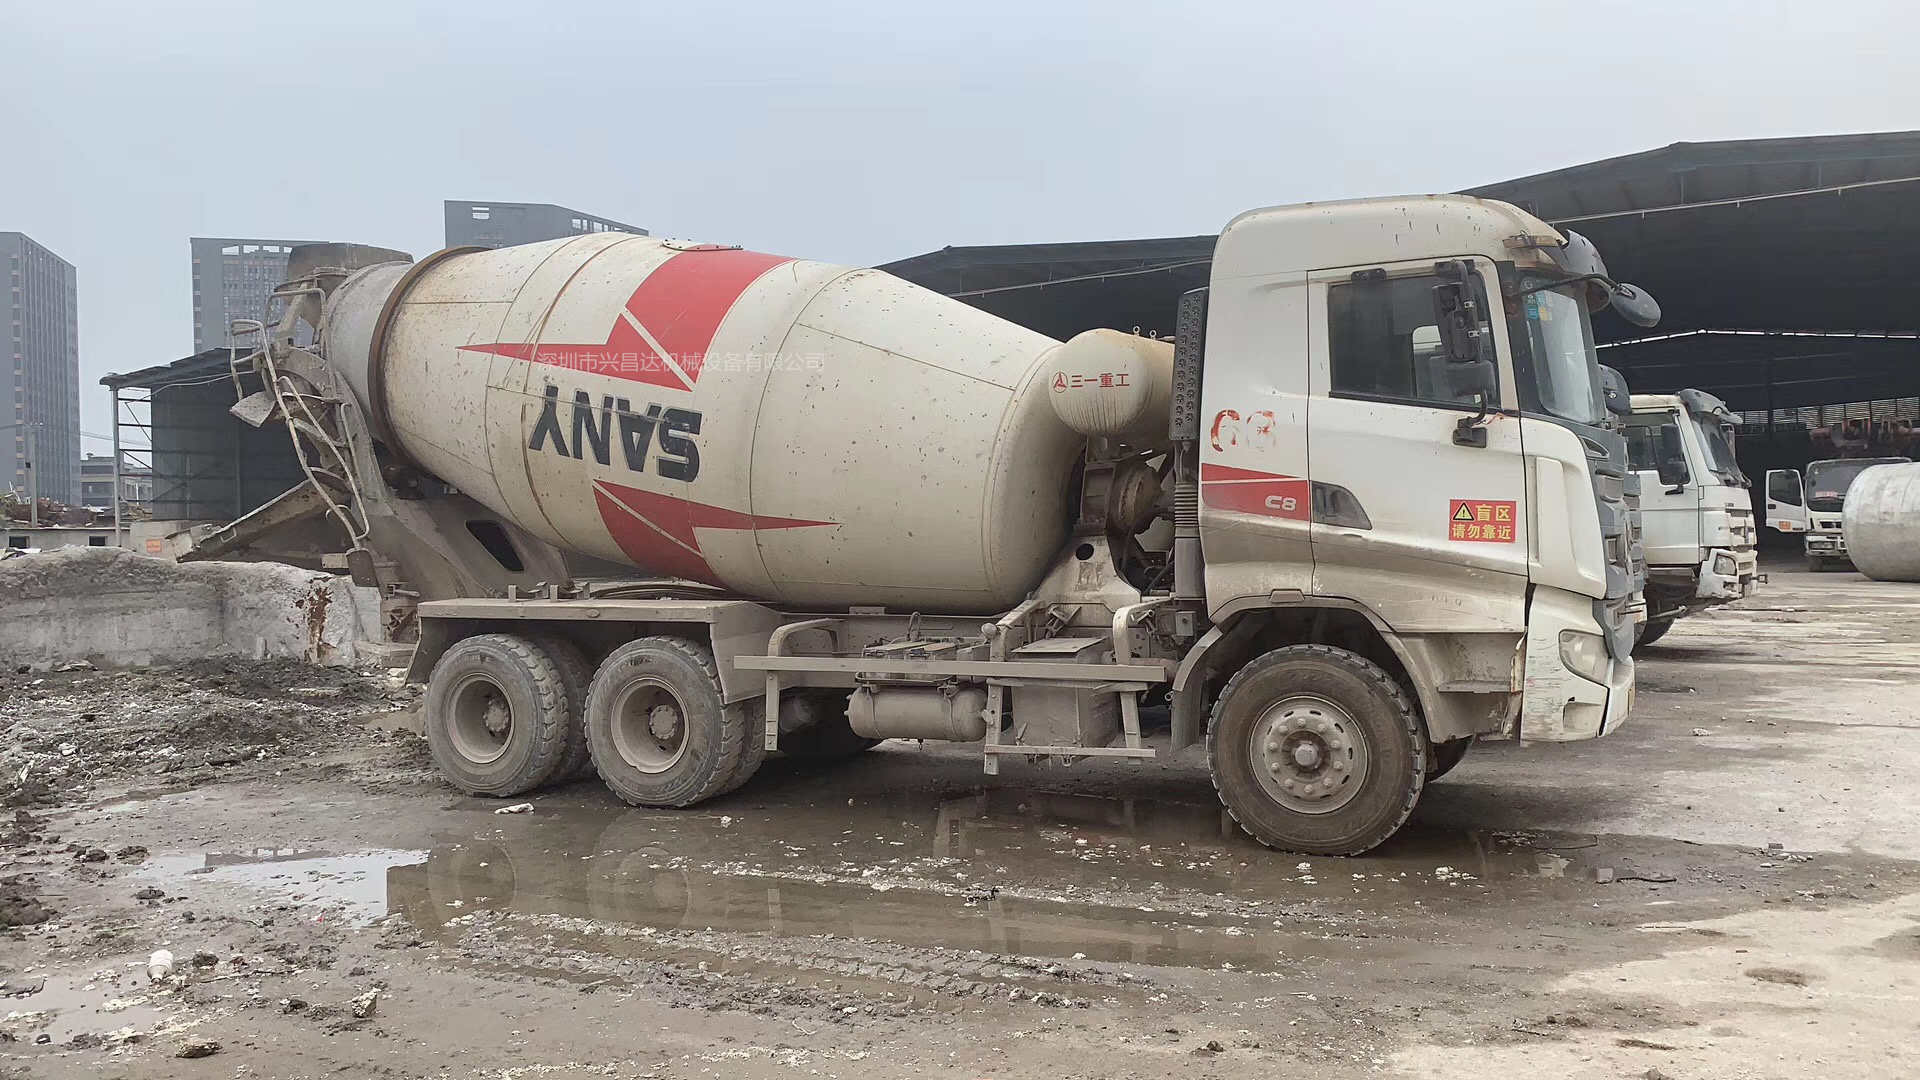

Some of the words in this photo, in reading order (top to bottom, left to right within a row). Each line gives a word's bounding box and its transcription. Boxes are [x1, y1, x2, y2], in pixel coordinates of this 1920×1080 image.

[1071, 373, 1130, 388] 三一重工
[529, 384, 702, 483] SANY
[1265, 495, 1297, 511] C8
[1475, 504, 1511, 521] 盲区
[1452, 523, 1511, 539] 请勿靠近
